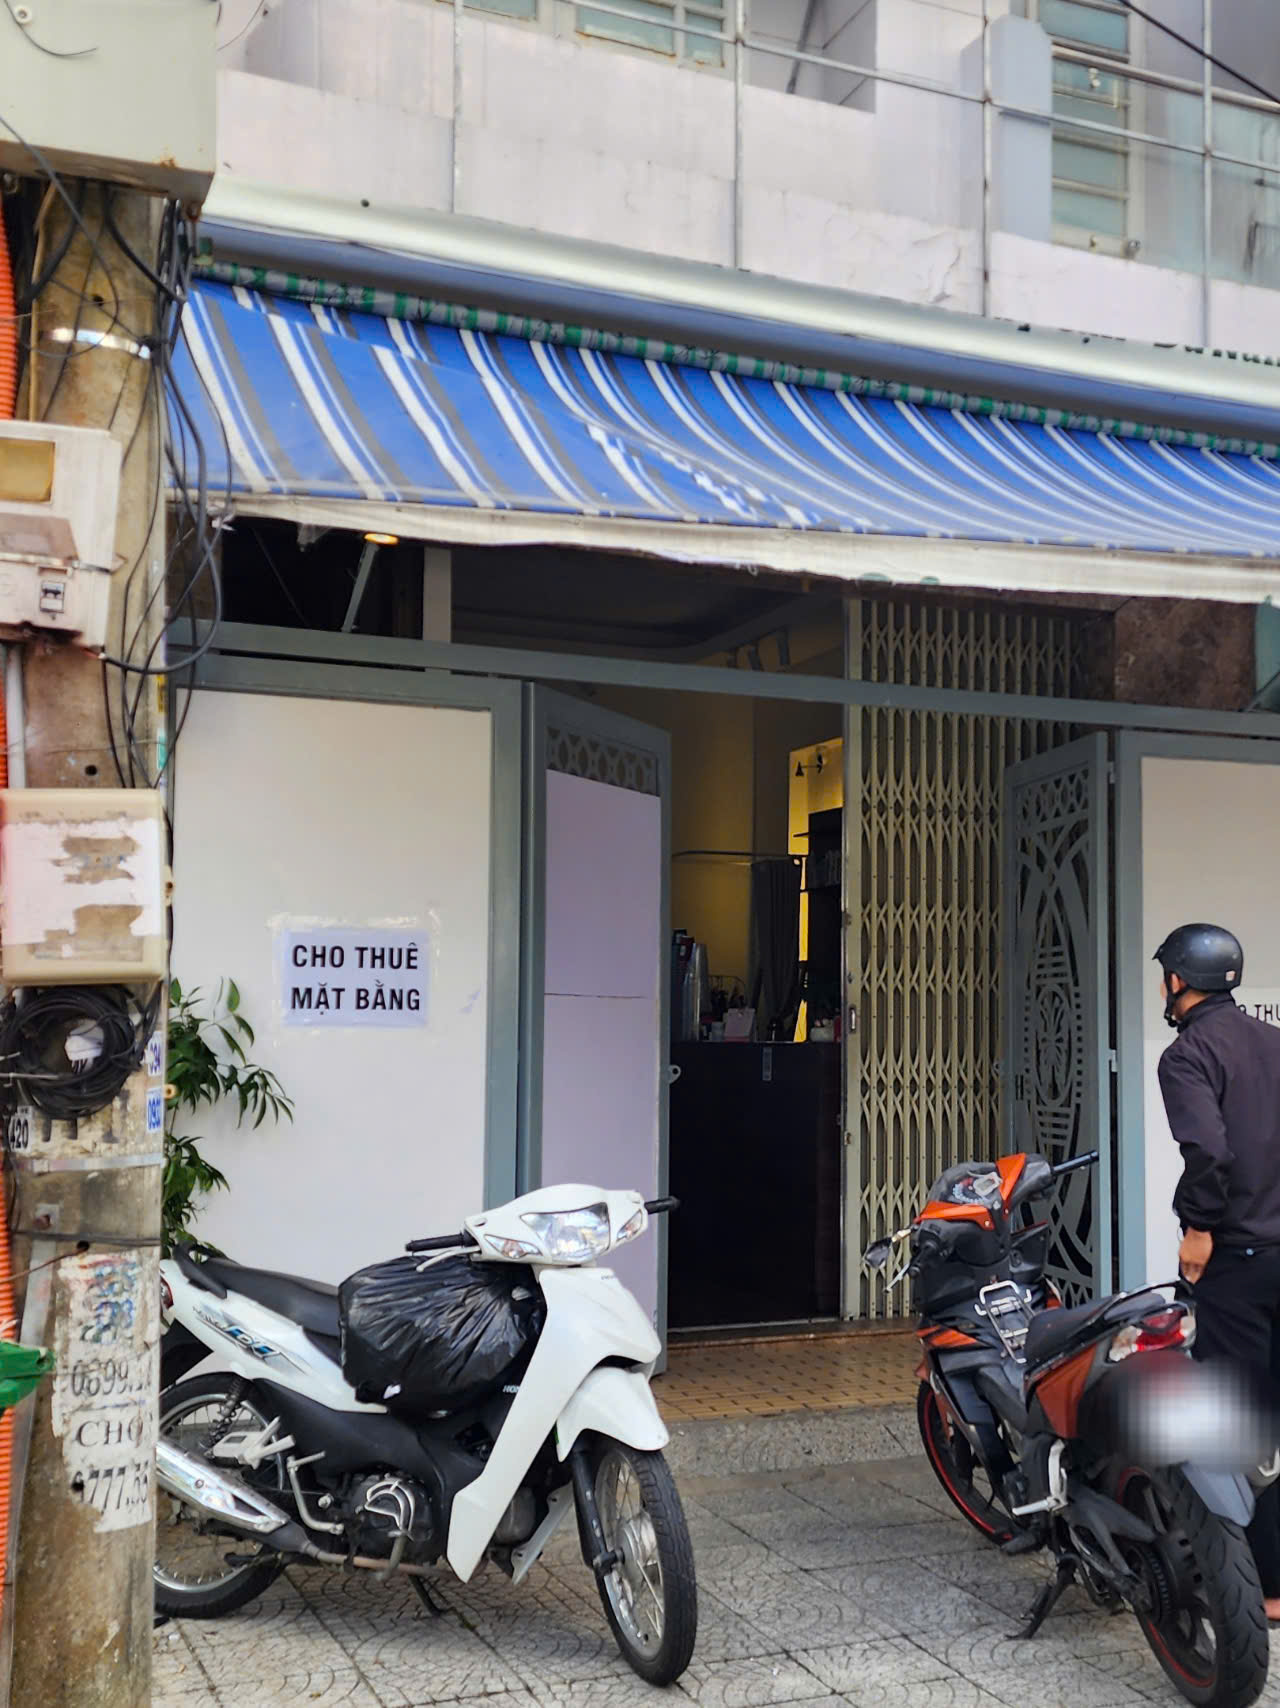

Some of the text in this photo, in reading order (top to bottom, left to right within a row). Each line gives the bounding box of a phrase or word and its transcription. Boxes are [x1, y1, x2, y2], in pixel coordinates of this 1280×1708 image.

[292, 942, 418, 970] CHO THUÊ
[291, 979, 420, 1015] MẶT BẰNG
